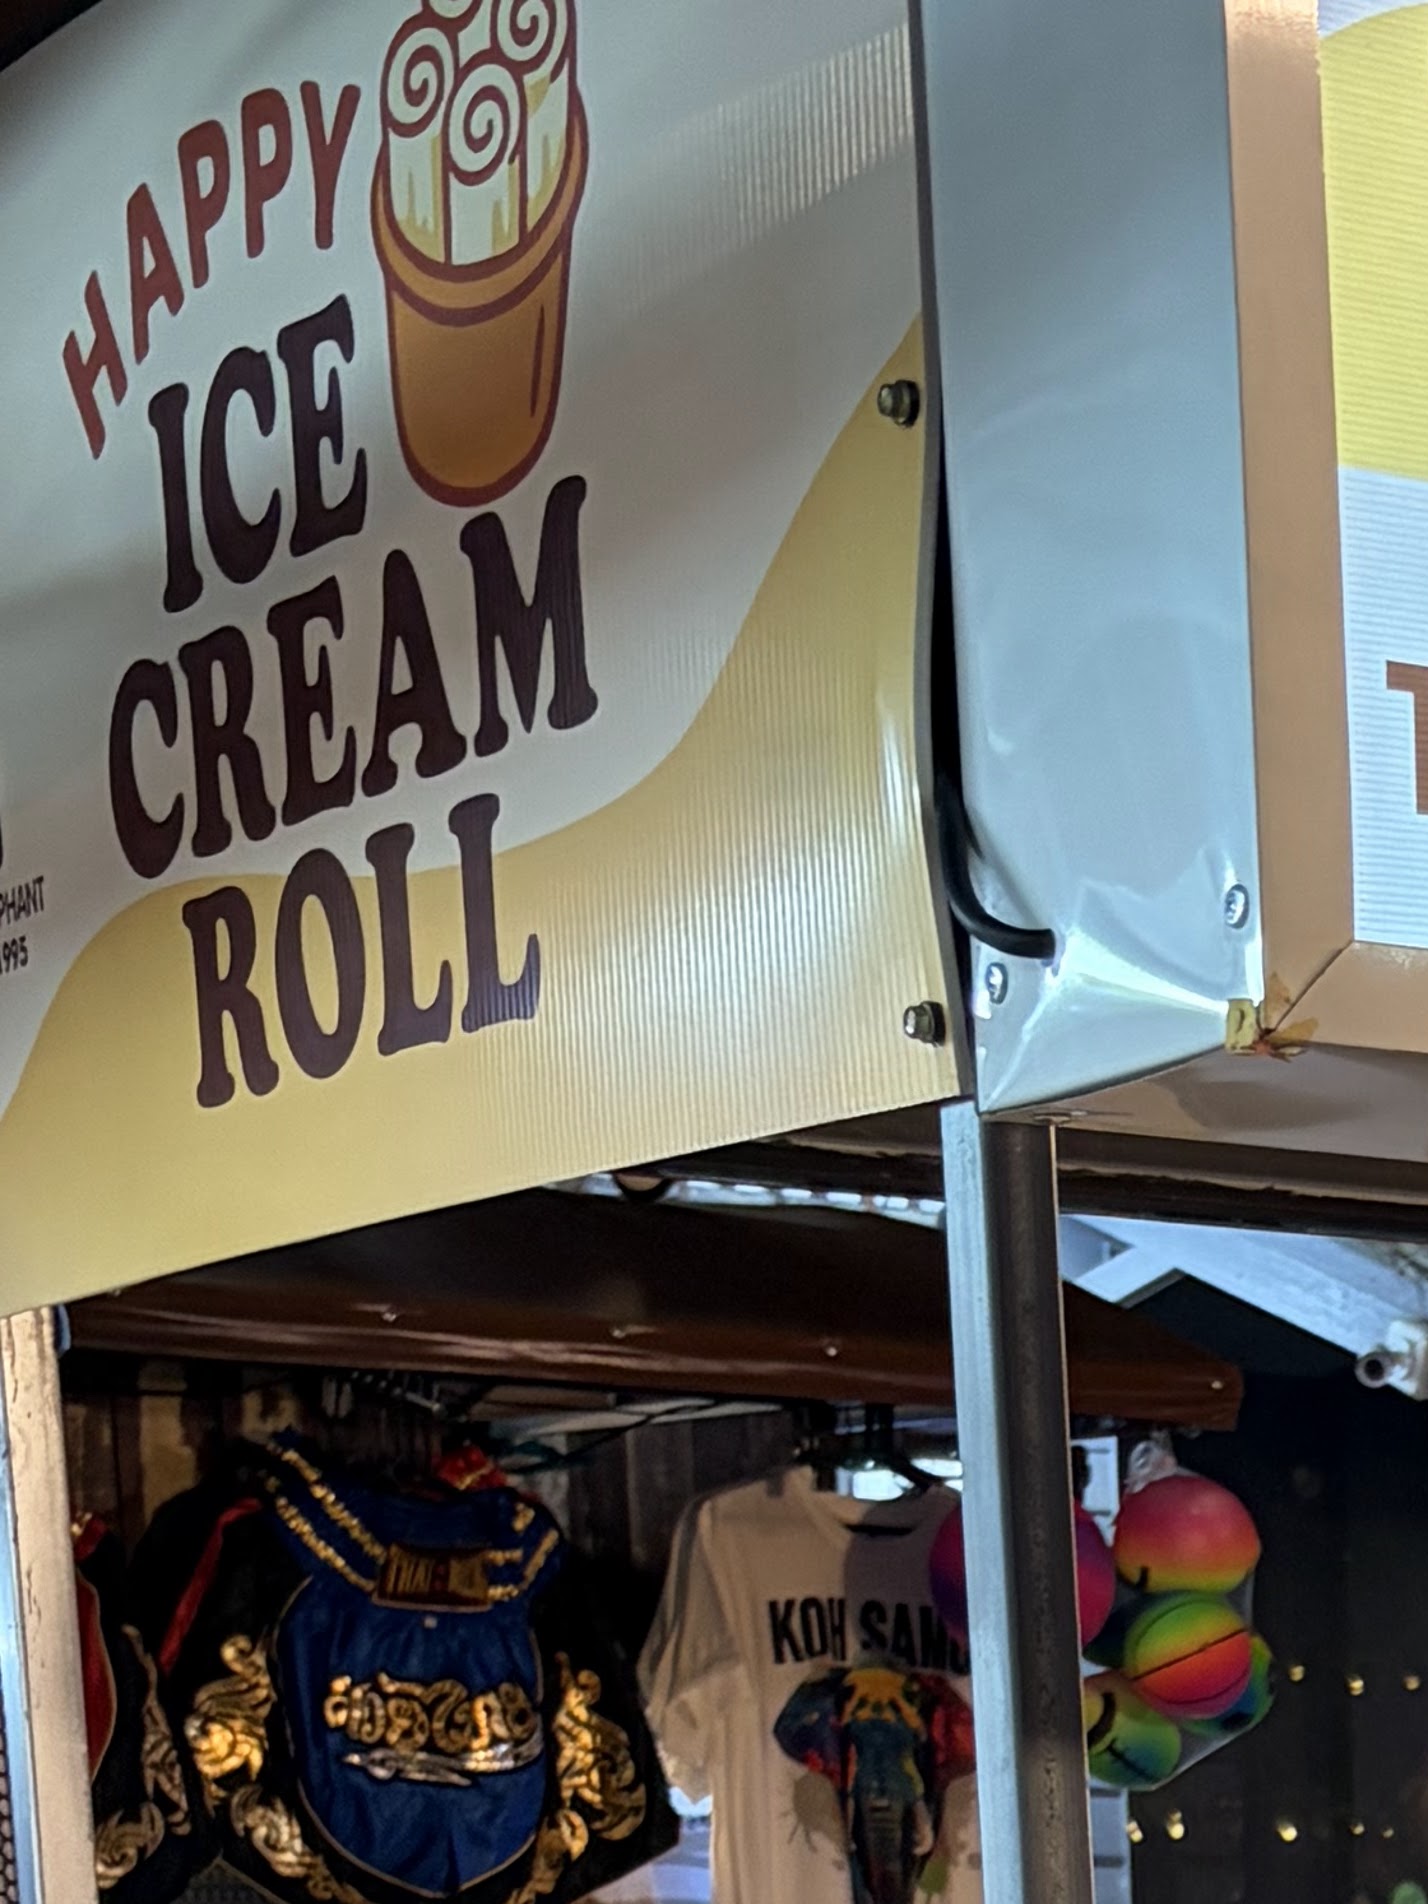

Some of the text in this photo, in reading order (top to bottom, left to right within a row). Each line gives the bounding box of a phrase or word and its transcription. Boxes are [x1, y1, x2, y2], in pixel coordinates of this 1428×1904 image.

[63, 81, 361, 459] HAPPY
[148, 295, 367, 612] ICE
[108, 474, 599, 880] CREAM
[182, 794, 540, 1108] ROLL
[769, 1597, 847, 1664] KOH
